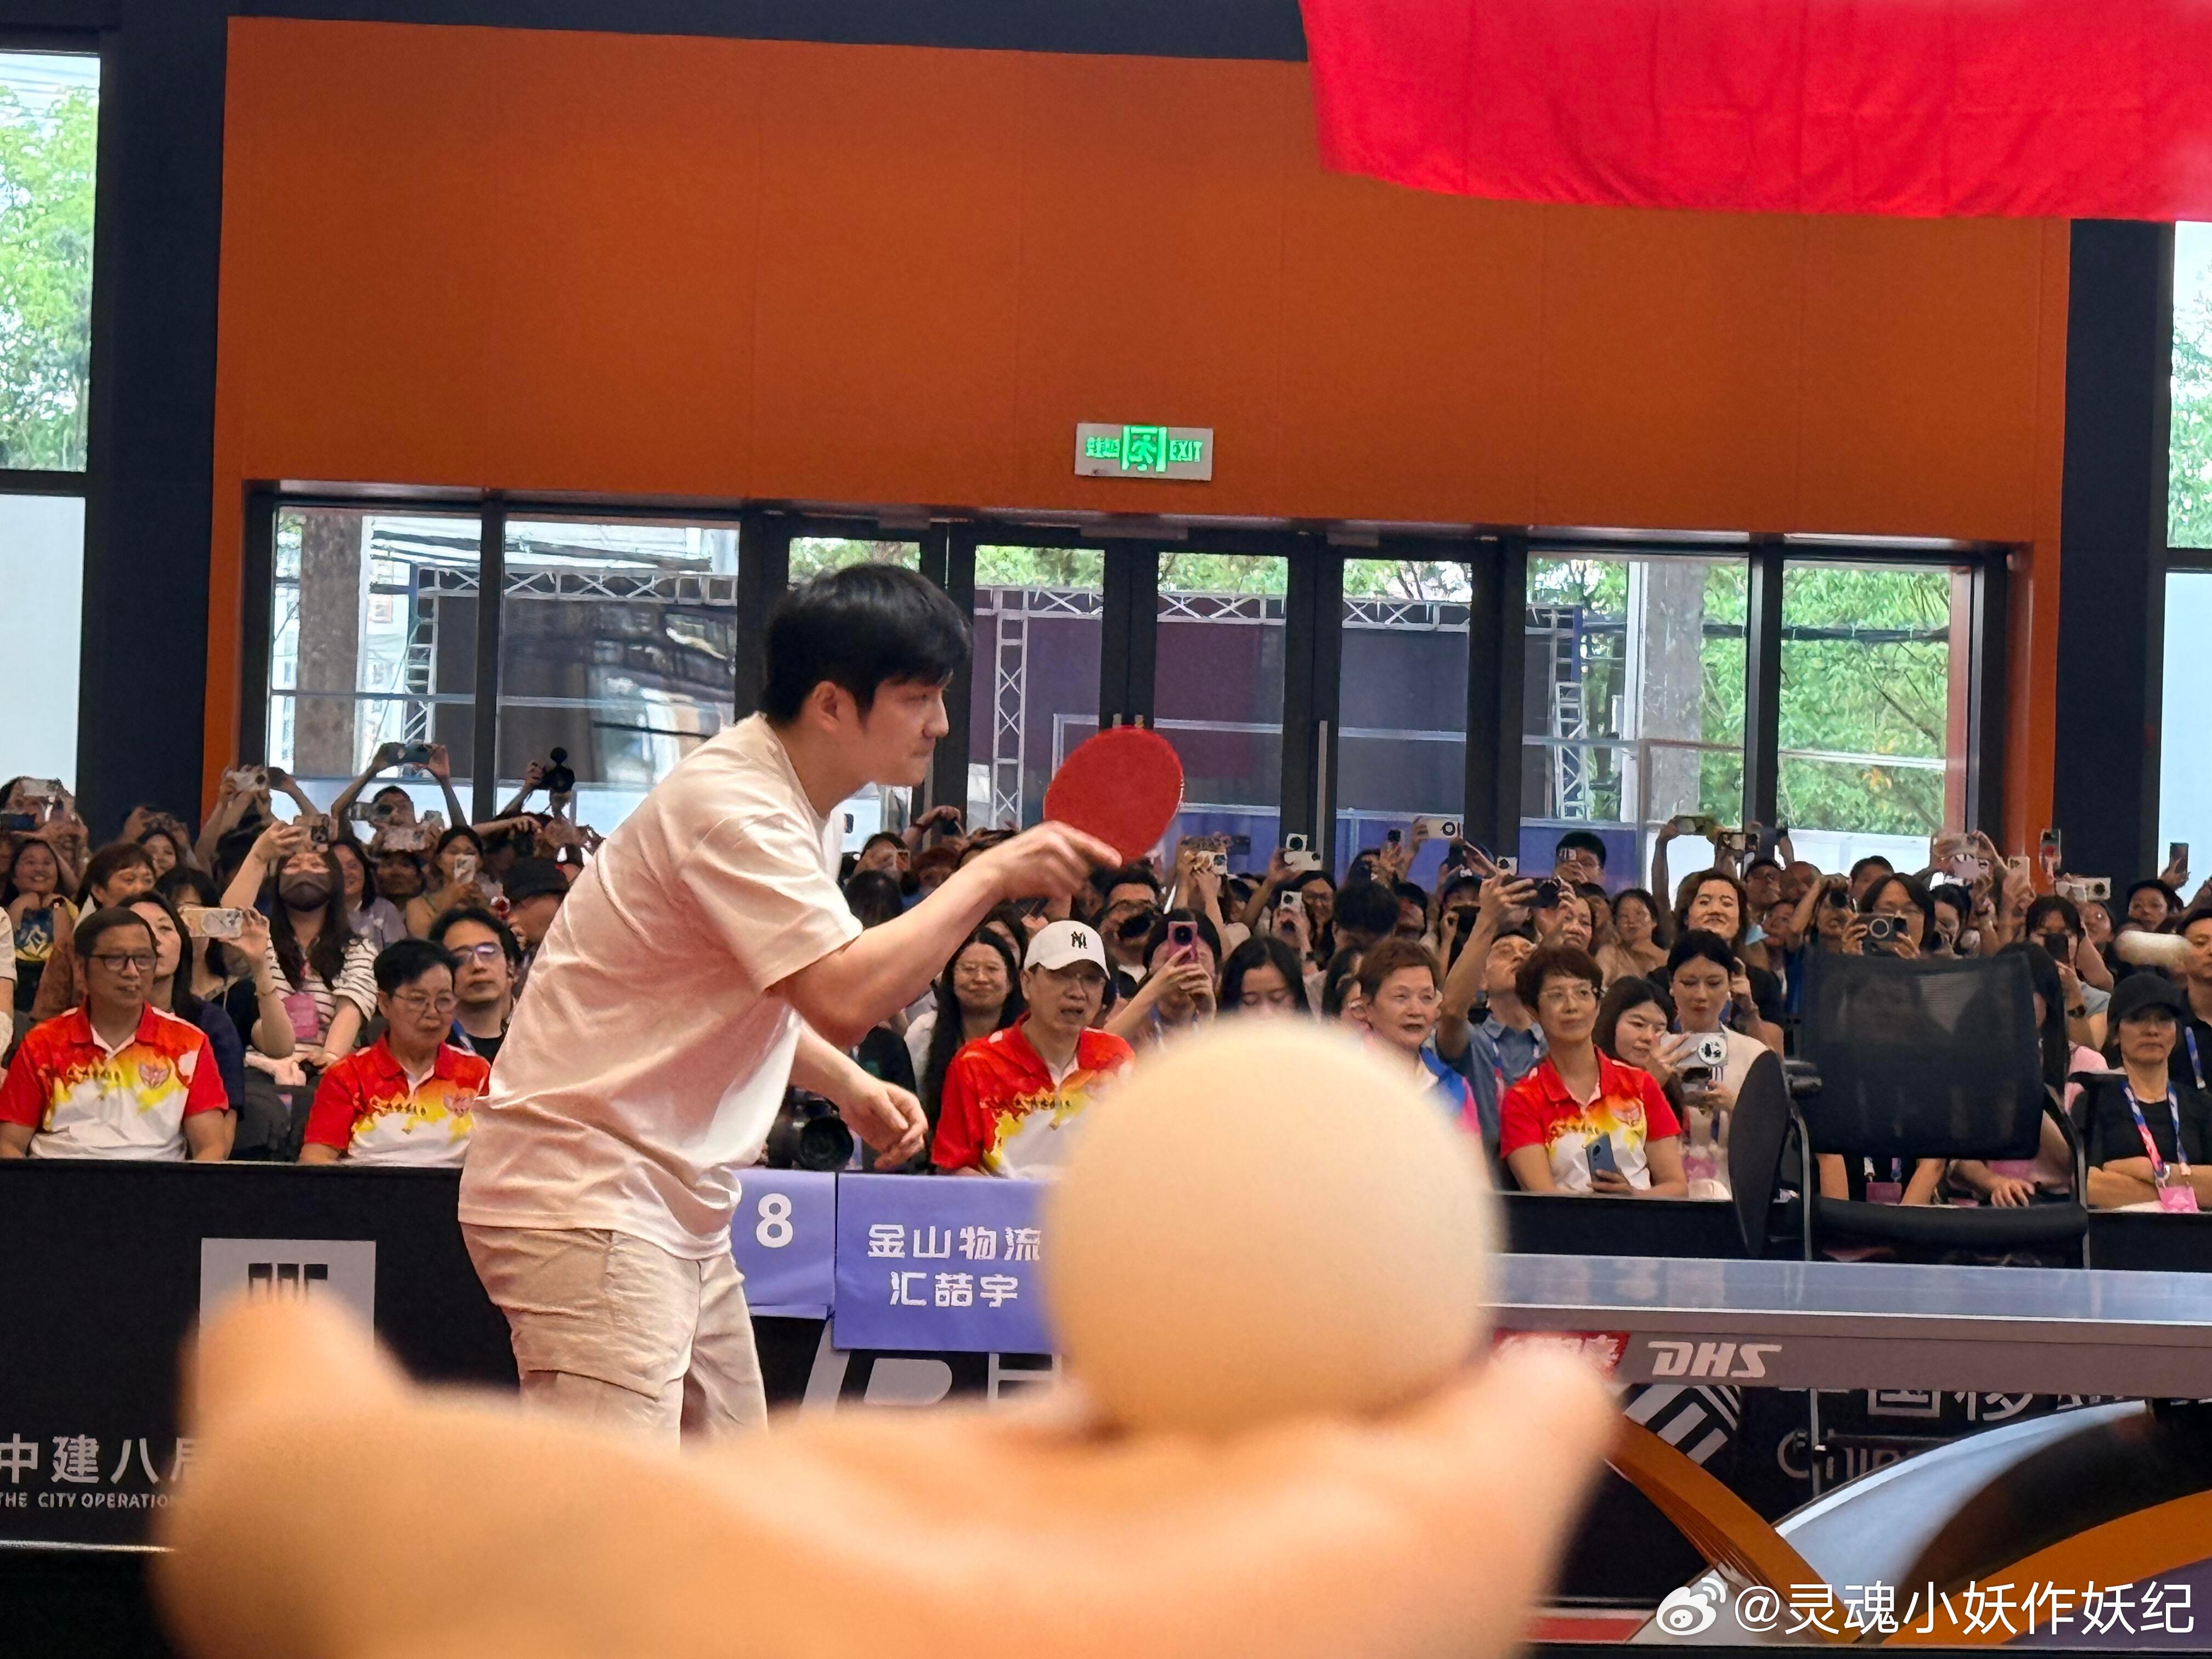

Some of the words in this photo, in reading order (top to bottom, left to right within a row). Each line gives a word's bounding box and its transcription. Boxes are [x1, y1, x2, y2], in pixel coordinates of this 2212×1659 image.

[1169, 439, 1203, 462] EXIT
[756, 1193, 793, 1248] 8
[867, 1223, 1041, 1261] 金山物流
[890, 1271, 1019, 1307] 汇喆宇
[1647, 1340, 1783, 1378] DHS
[38, 1492, 76, 1509] CITY
